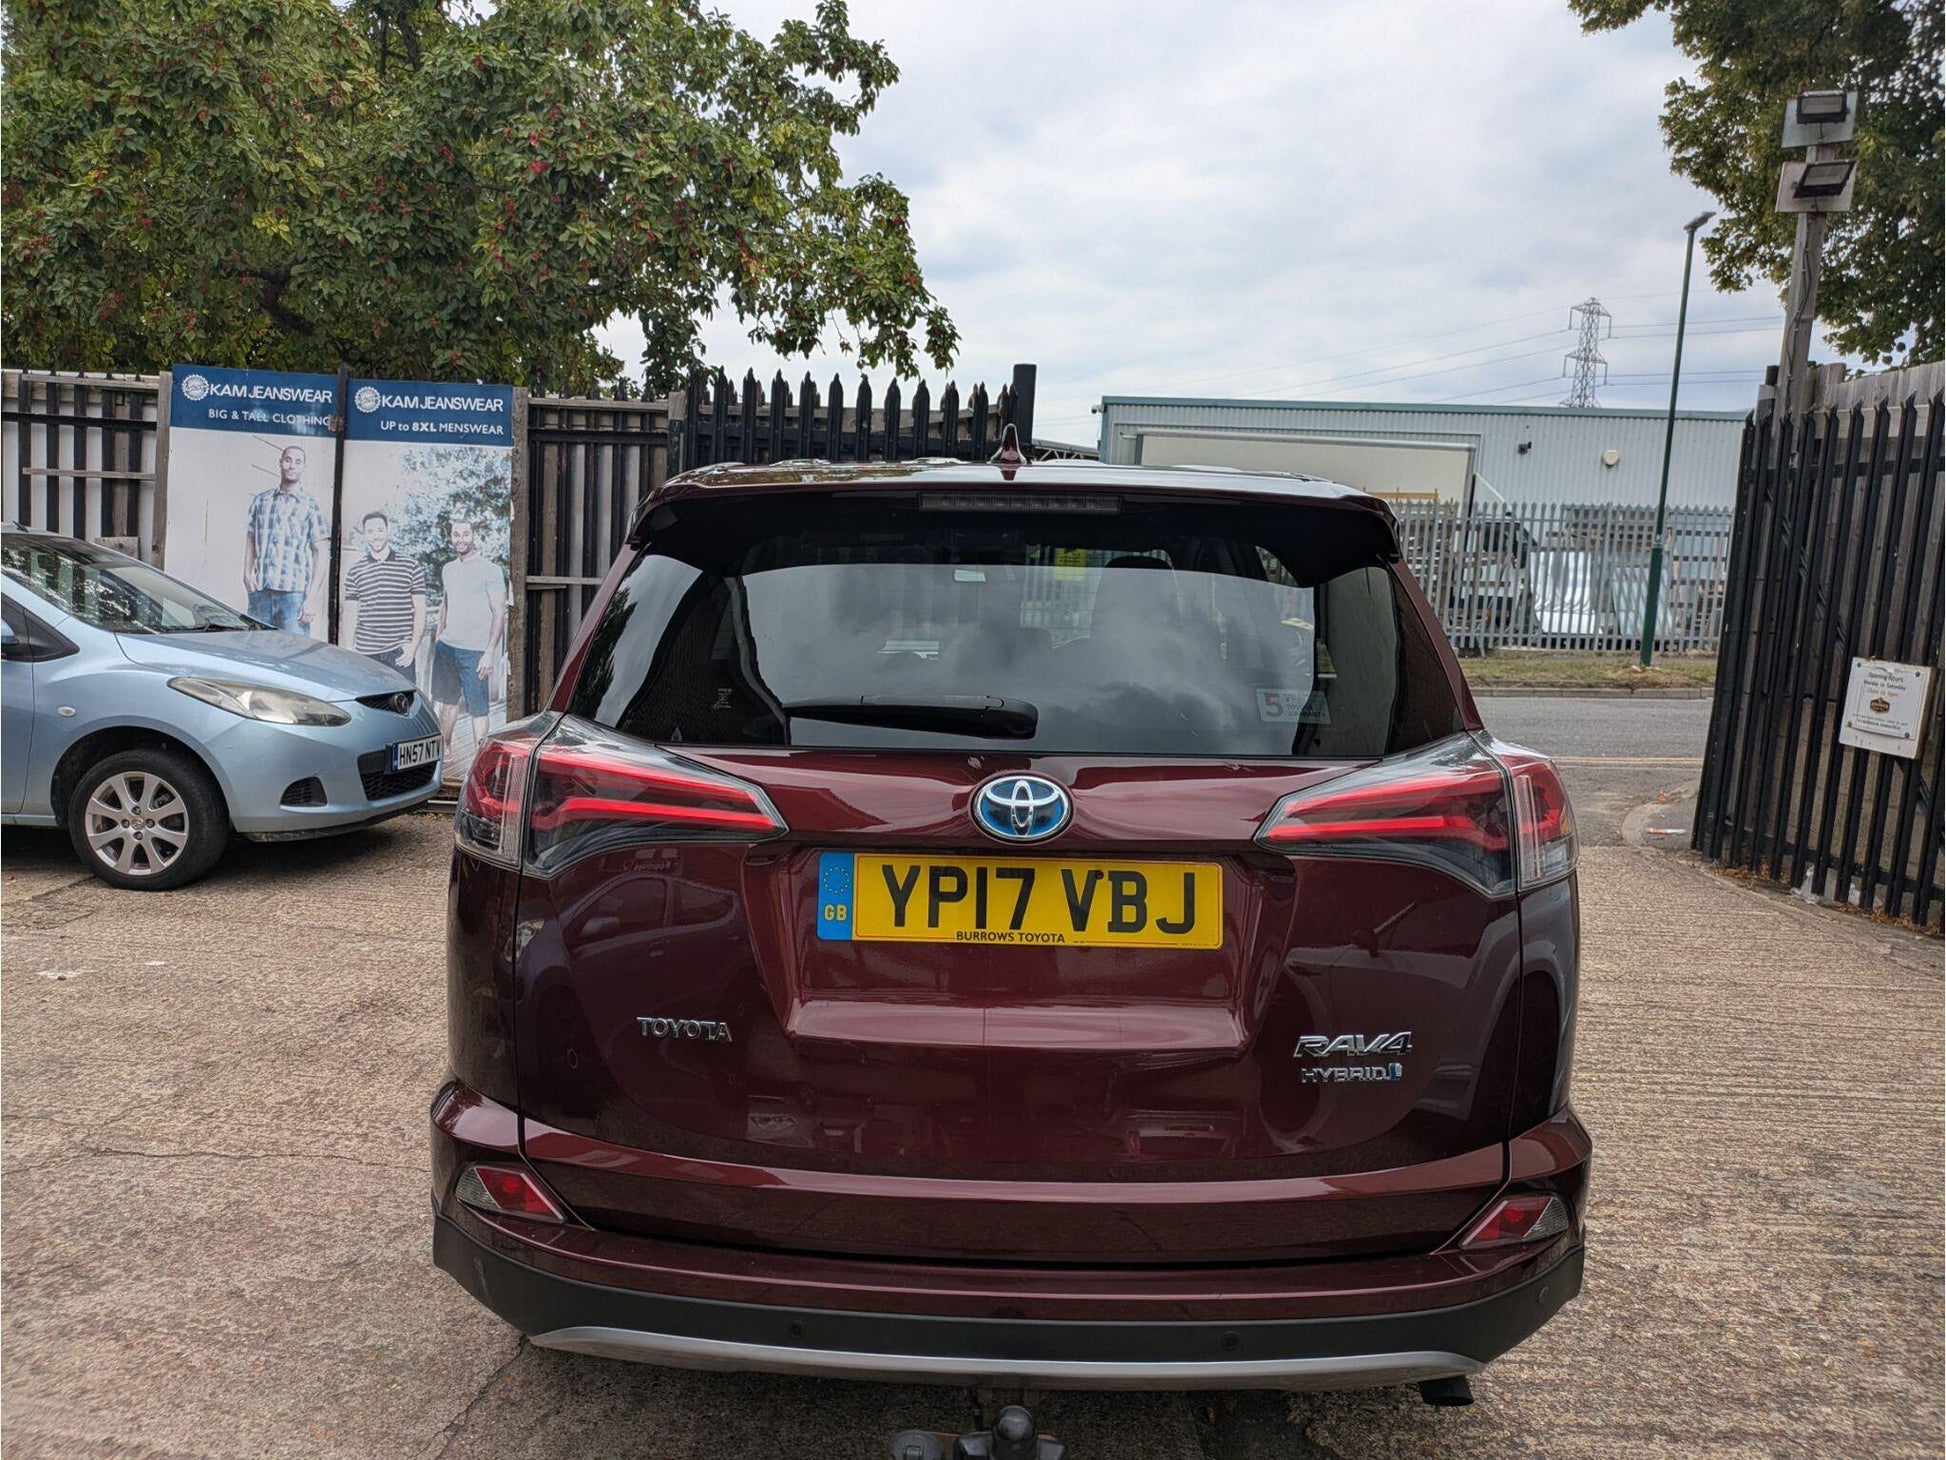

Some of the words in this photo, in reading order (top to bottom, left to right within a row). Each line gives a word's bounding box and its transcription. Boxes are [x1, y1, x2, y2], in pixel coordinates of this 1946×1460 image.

[209, 383, 247, 398] KAM
[249, 385, 333, 404] JEANSWEAR
[381, 395, 419, 409] KAM
[420, 396, 504, 412] JEANSWEAR
[208, 408, 228, 420] BIG
[231, 411, 240, 420] &
[241, 410, 269, 422] TALL
[272, 413, 331, 427] CLOTHING
[380, 420, 397, 431] UP
[398, 422, 409, 431] to
[412, 422, 437, 432] 8XL
[439, 423, 504, 436] MENSWEAR
[1265, 692, 1284, 717] 5
[400, 743, 424, 766] HN57
[881, 864, 1036, 931] YP17
[1060, 868, 1196, 935] VBJ
[824, 904, 847, 921] GB
[956, 930, 1015, 942] BURROWS
[1018, 932, 1066, 944] TOYOTA
[636, 1016, 733, 1042] TOYOTA
[1293, 1031, 1413, 1058] RAV4
[1301, 1066, 1387, 1083] HYBRID
